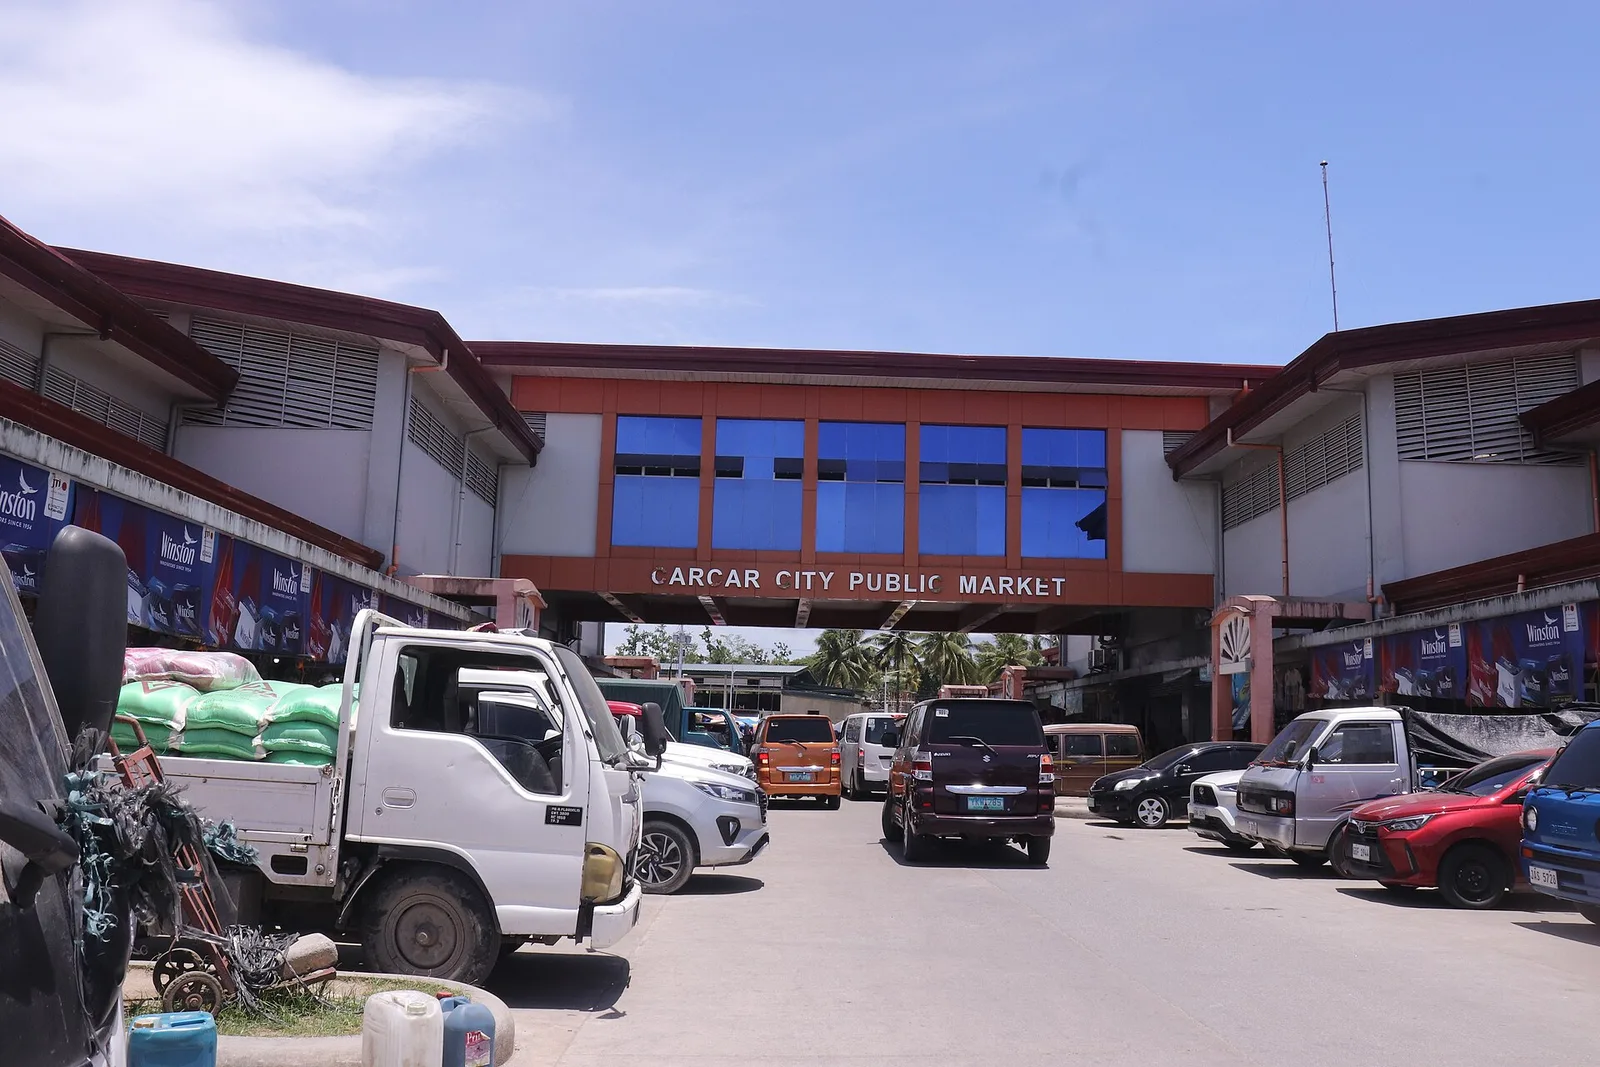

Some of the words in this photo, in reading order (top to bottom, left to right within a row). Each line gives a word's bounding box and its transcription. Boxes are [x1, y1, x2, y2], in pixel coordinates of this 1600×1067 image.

[0, 490, 36, 521] nston
[161, 531, 196, 566] Winston
[651, 567, 760, 588] CARCAR
[775, 570, 835, 590] CITY
[849, 572, 942, 594] PUBLIC
[960, 575, 1065, 596] MARKET
[1526, 623, 1560, 642] Winston
